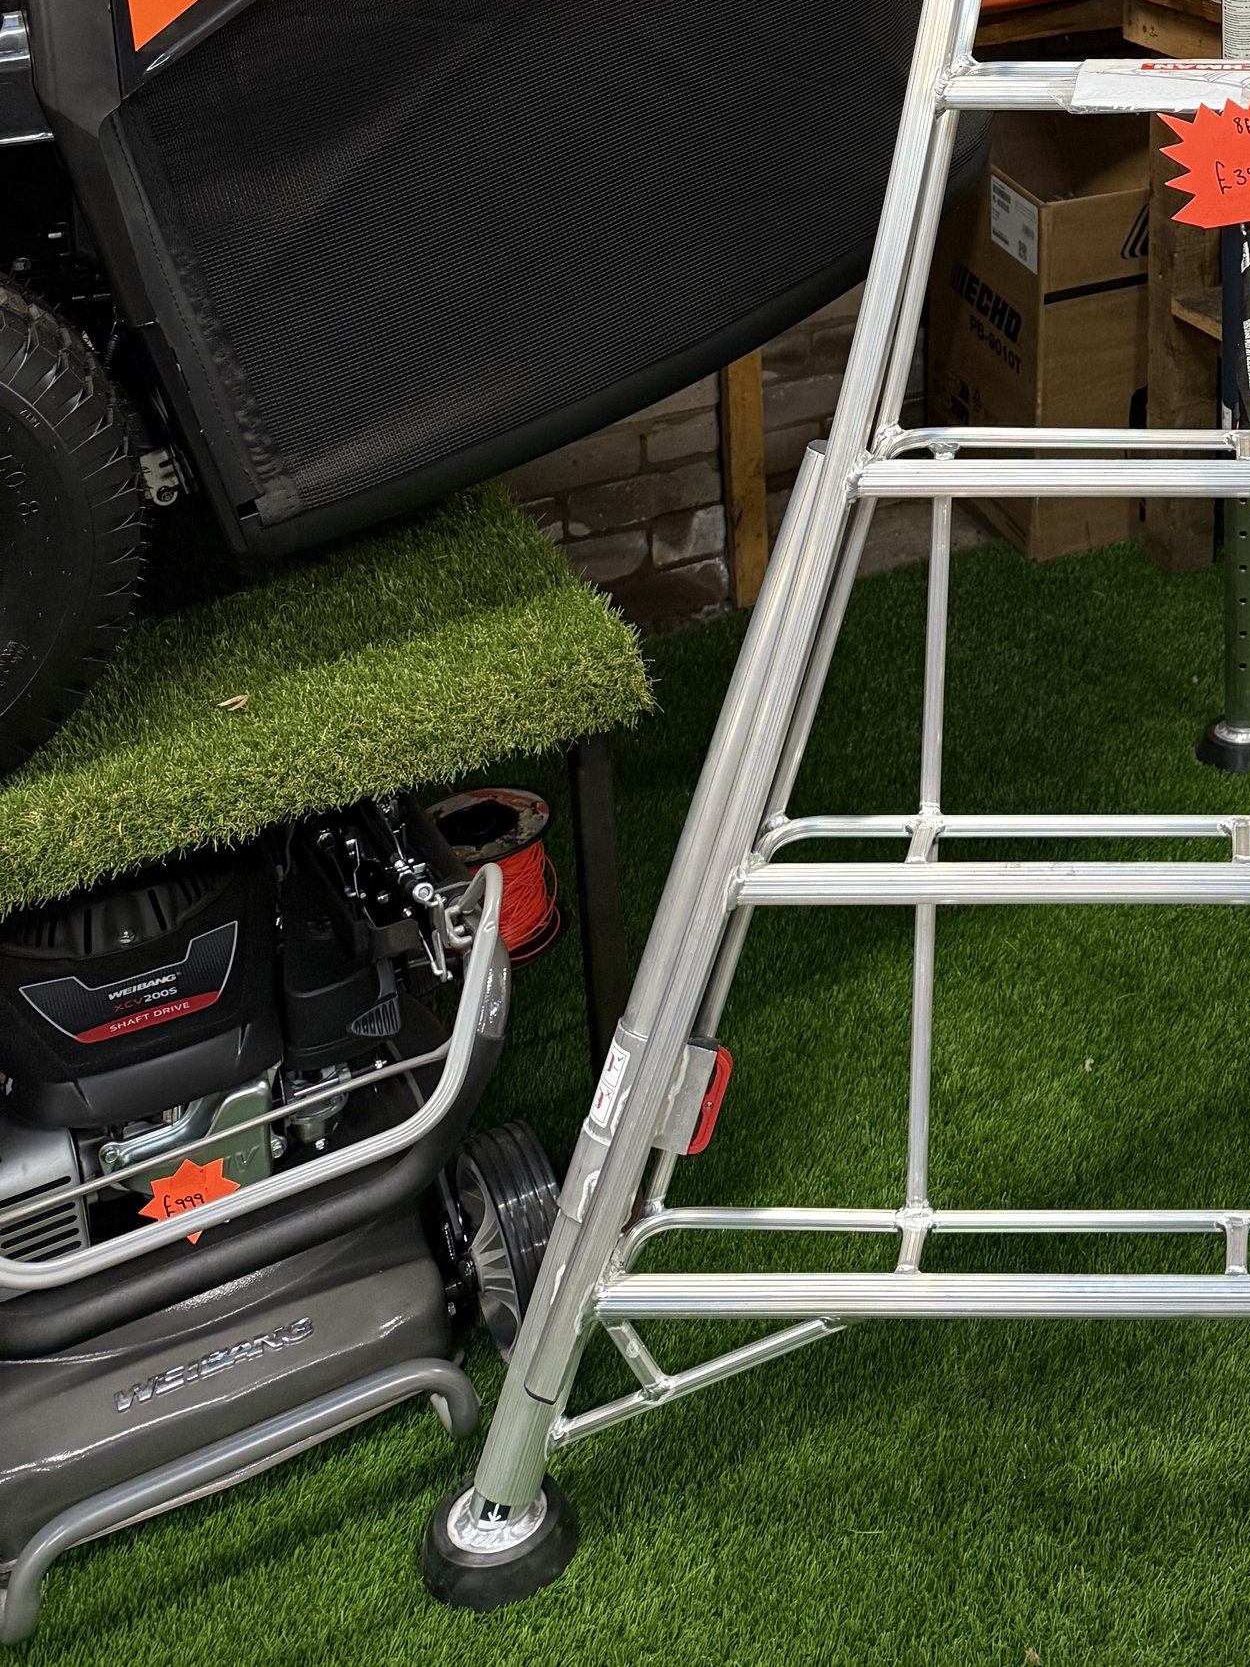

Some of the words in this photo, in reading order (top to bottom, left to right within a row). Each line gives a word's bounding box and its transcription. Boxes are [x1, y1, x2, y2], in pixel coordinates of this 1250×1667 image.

[963, 266, 1023, 344] ECHO
[108, 973, 177, 1000] WEIBANG
[114, 986, 178, 1012] XCV200S
[109, 1013, 150, 1033] SHAFT
[153, 1001, 191, 1018] DRIVE
[113, 1317, 314, 1414] WEIBANG
